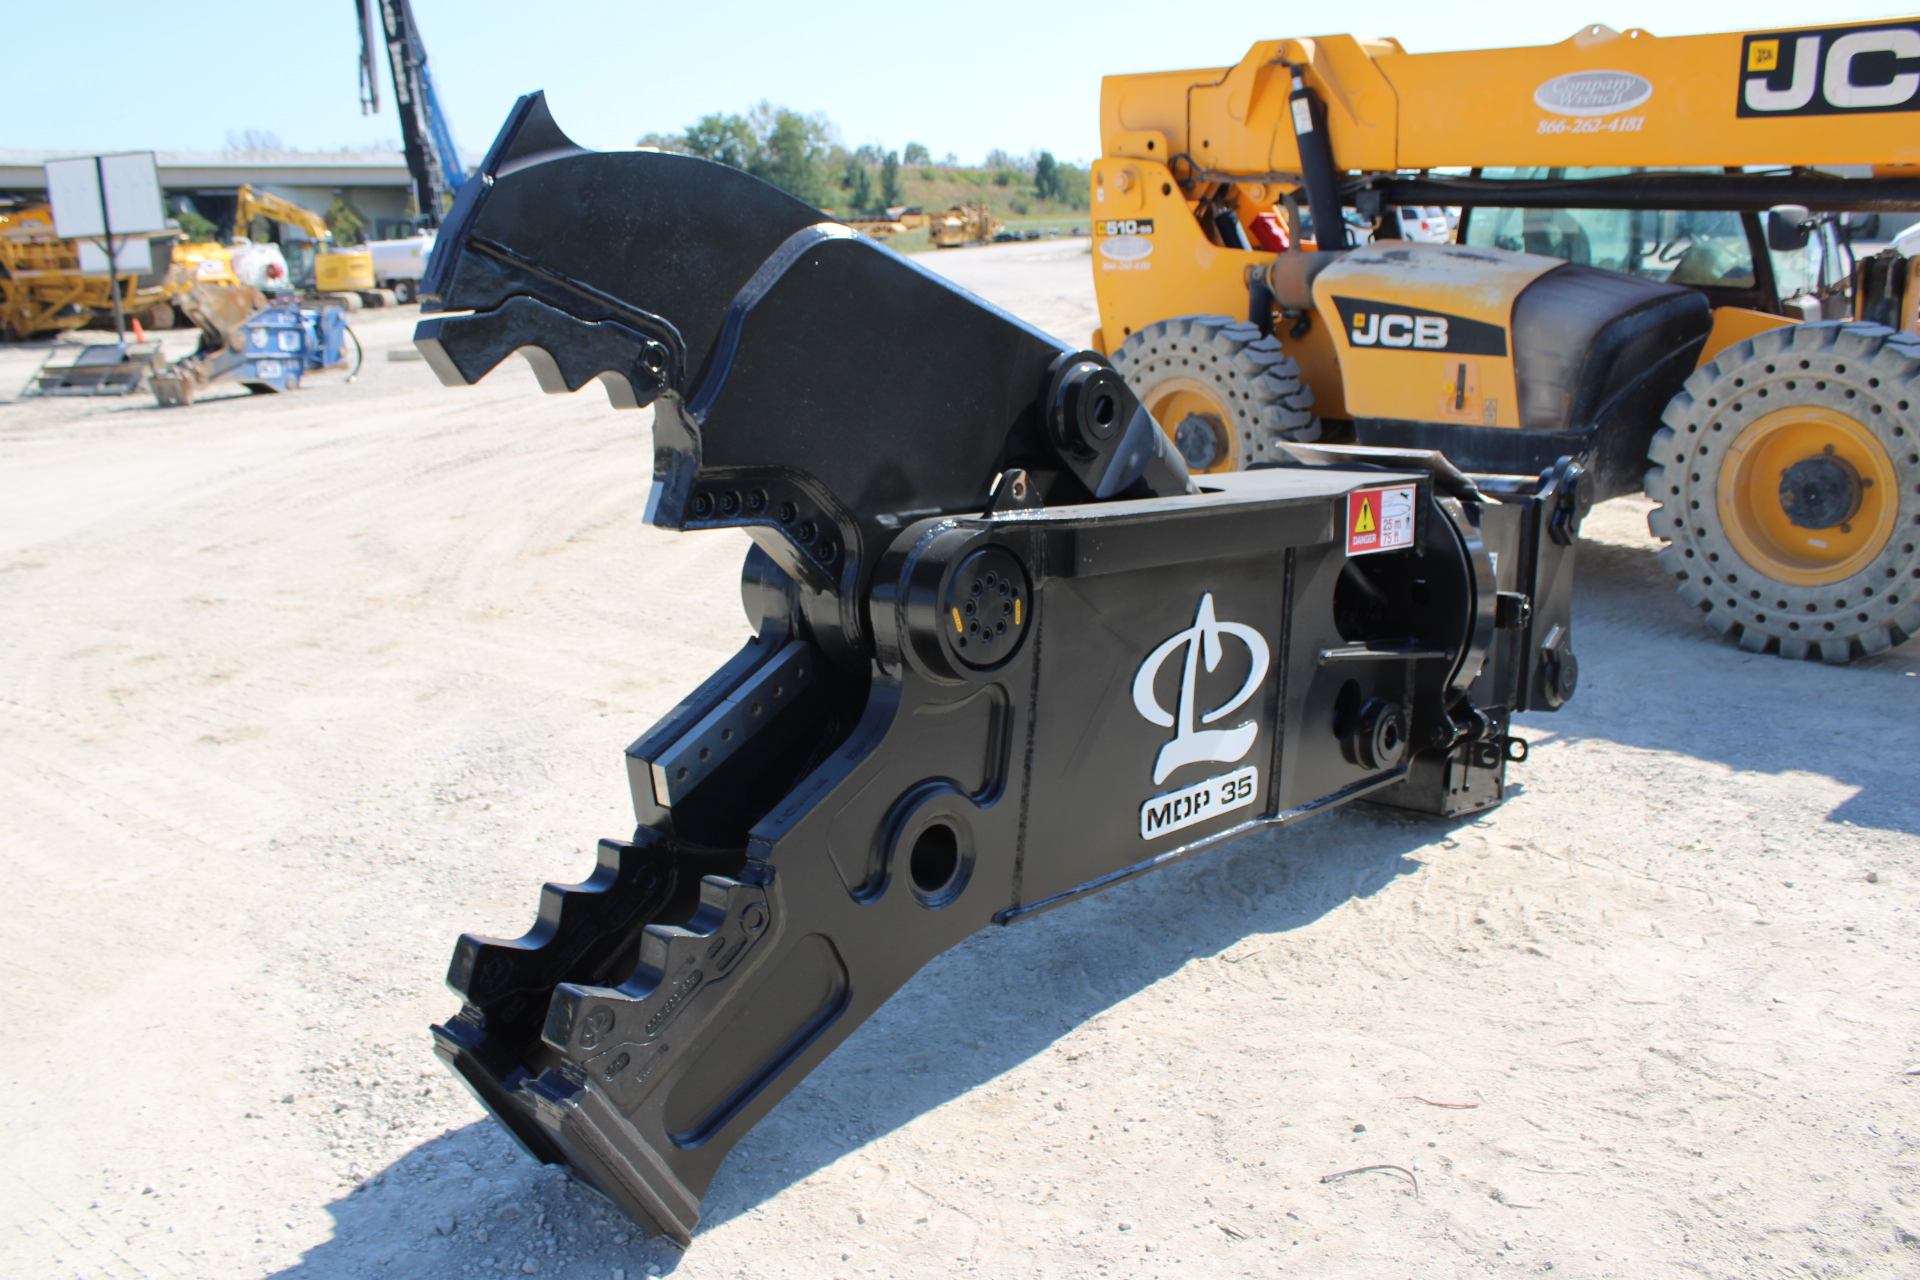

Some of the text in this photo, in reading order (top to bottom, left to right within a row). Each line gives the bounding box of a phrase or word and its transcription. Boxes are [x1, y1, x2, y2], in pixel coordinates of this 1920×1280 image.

[1552, 78, 1636, 95] Company
[1560, 90, 1623, 106] Wrench
[1536, 117, 1645, 134] 866-262-4181
[1352, 313, 1448, 349] JCB
[1383, 519, 1402, 531] 25 m
[1352, 533, 1377, 546] DANGER
[1383, 531, 1400, 545] 75 ft
[1147, 775, 1252, 832] MDP 35
